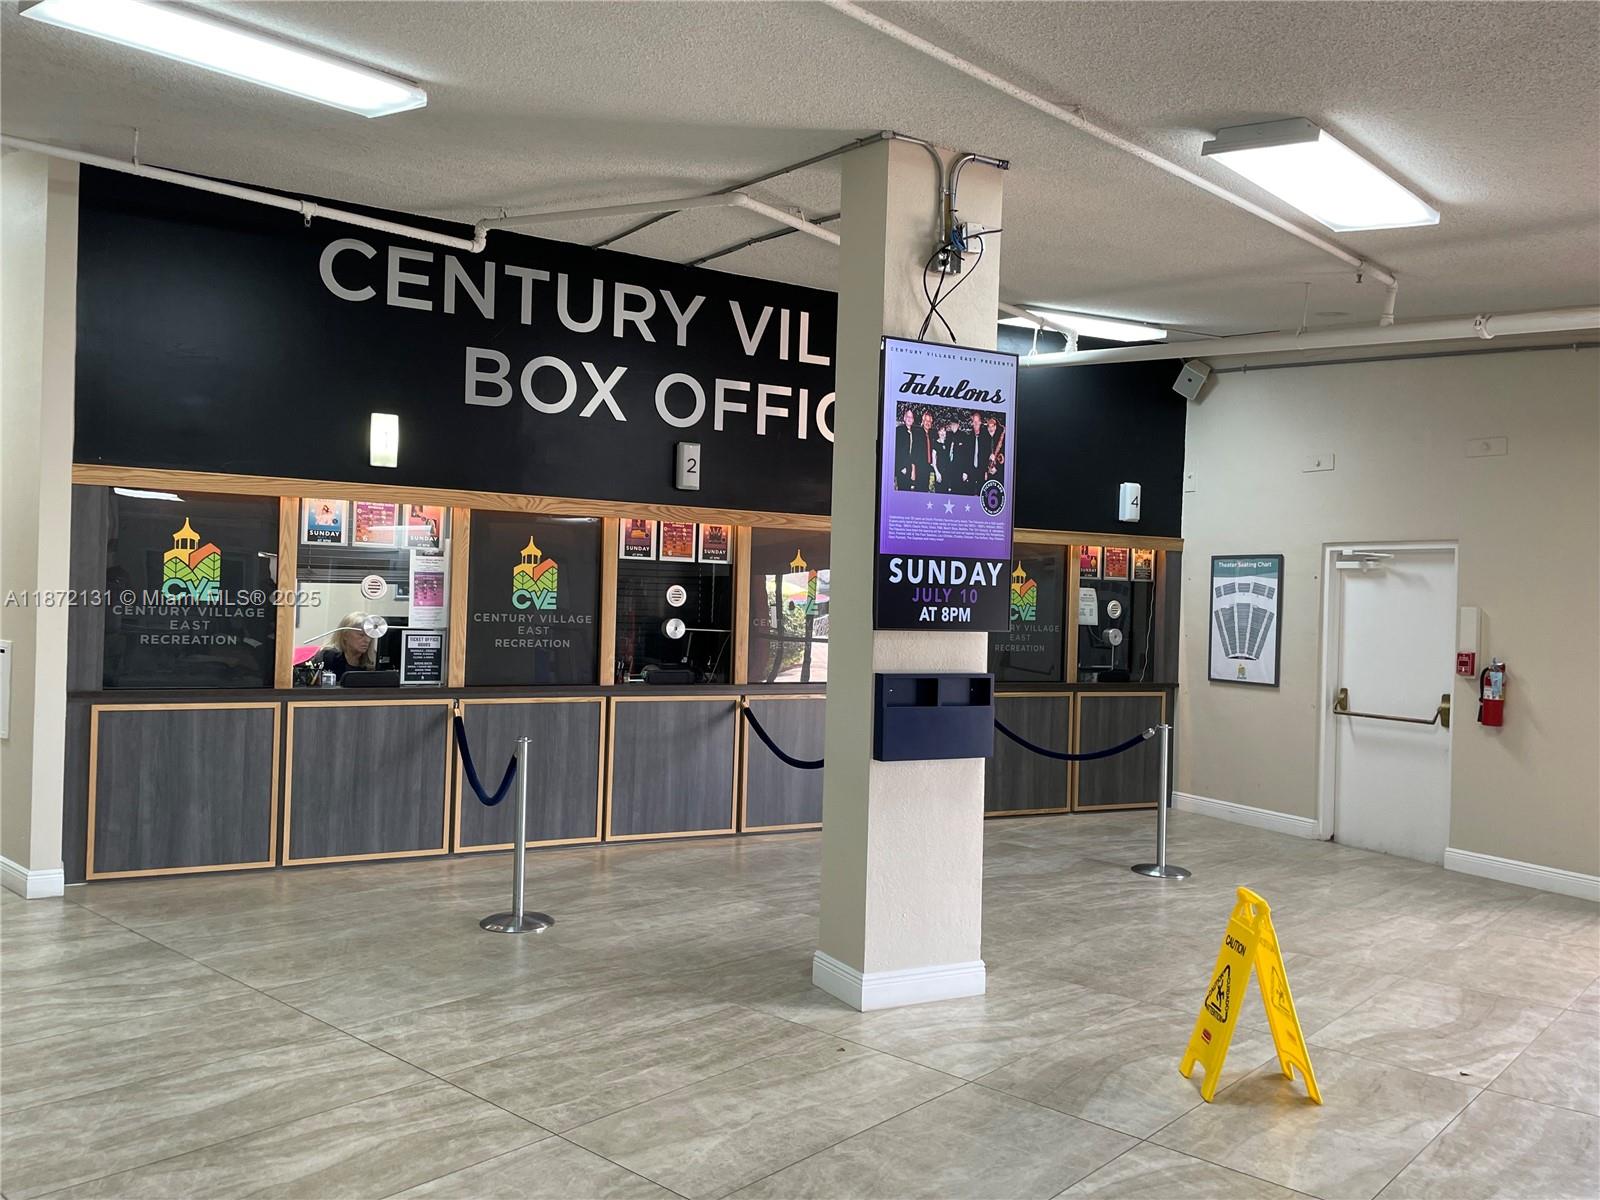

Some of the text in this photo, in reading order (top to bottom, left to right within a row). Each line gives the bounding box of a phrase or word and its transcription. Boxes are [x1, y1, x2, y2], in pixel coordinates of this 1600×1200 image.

[318, 237, 706, 347] CENTURY
[890, 346, 922, 355] CENTURY
[927, 351, 956, 360] VILLAGE
[981, 358, 1014, 367] PRESENTS
[465, 346, 628, 422] BOX
[686, 457, 697, 474] 2
[987, 488, 999, 509] 6
[1131, 495, 1139, 509] 4
[309, 529, 340, 537] SUNDAY
[889, 557, 1003, 587] SUNDAY
[1237, 561, 1257, 569] Seating
[512, 588, 558, 610] CVE
[912, 587, 978, 604] JULY 10
[112, 605, 265, 618] CENTURY VILLAGE
[473, 613, 592, 624] CENTURY VILLAGE
[919, 606, 971, 622] AT 8PM
[170, 620, 211, 630] EAST
[518, 626, 549, 635] EAST
[1024, 625, 1060, 633] VILLAGE
[139, 634, 237, 645] RECREATION
[495, 639, 570, 648] RECREATION
[994, 643, 1045, 652] RECREATION
[1226, 935, 1247, 957] CAUTION
